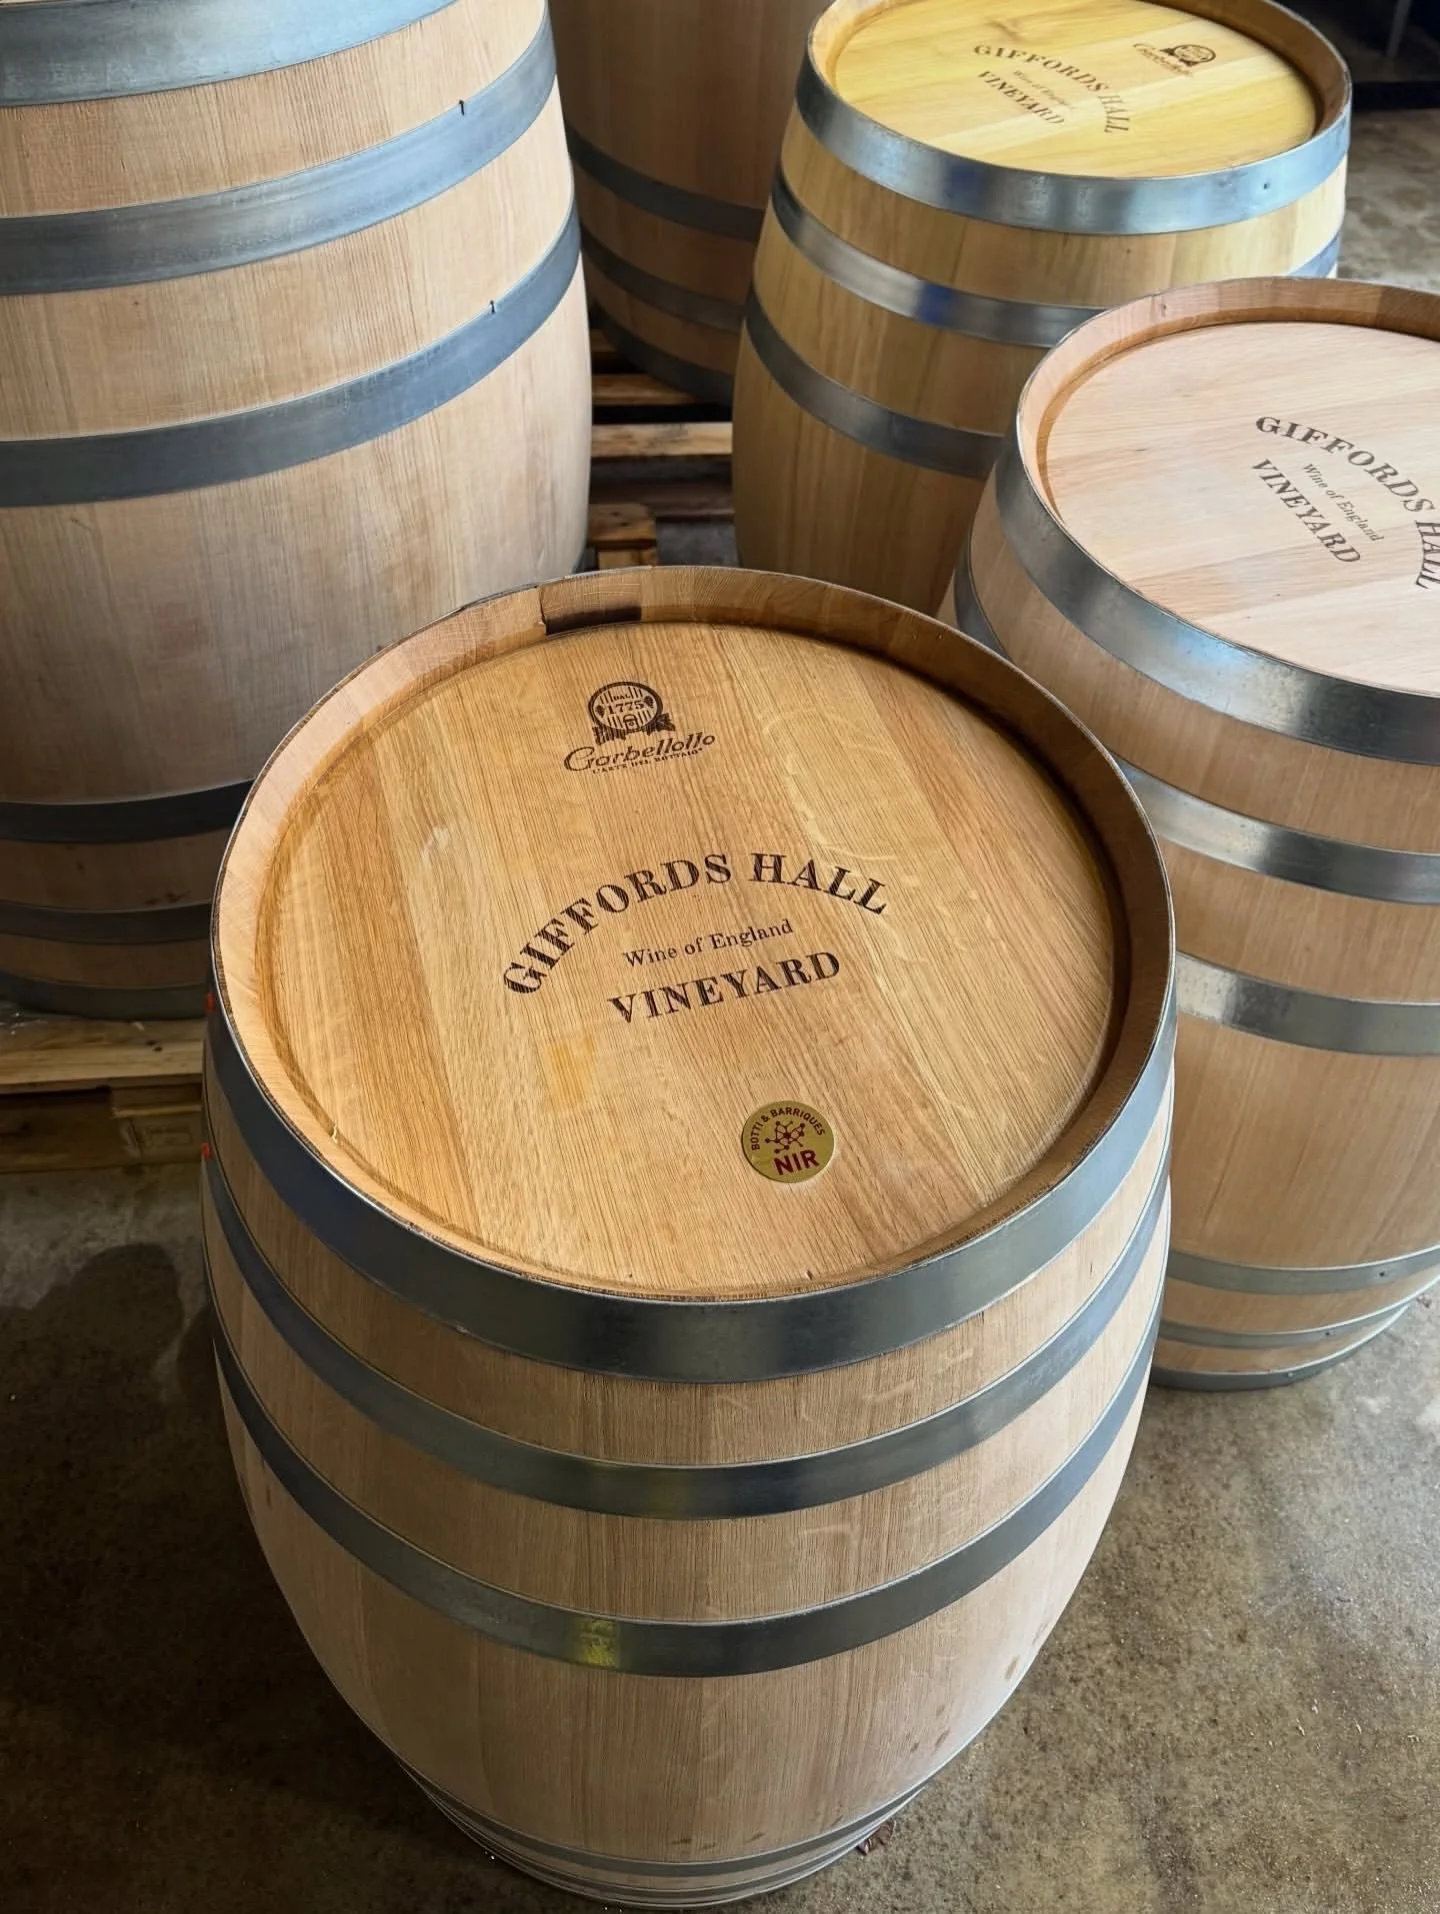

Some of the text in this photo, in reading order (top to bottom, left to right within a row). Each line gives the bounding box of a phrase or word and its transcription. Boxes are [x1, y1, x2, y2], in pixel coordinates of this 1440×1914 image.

[974, 45, 1109, 92] GIFFORDS
[1098, 95, 1130, 133] HALL
[978, 71, 1065, 124] VINEYARD
[1252, 459, 1361, 562] VINEYARD
[1256, 416, 1440, 589] GIFFORDS HALL
[1303, 463, 1384, 541] Wine of England
[608, 700, 644, 714] 1775
[503, 852, 888, 994] GIFFORDS HALL
[622, 918, 794, 967] Wine of England
[607, 950, 841, 1024] VINEYARD
[750, 1121, 764, 1151] BOTTI
[769, 1106, 826, 1136] BARRIQUES
[773, 1149, 820, 1176] NIR
